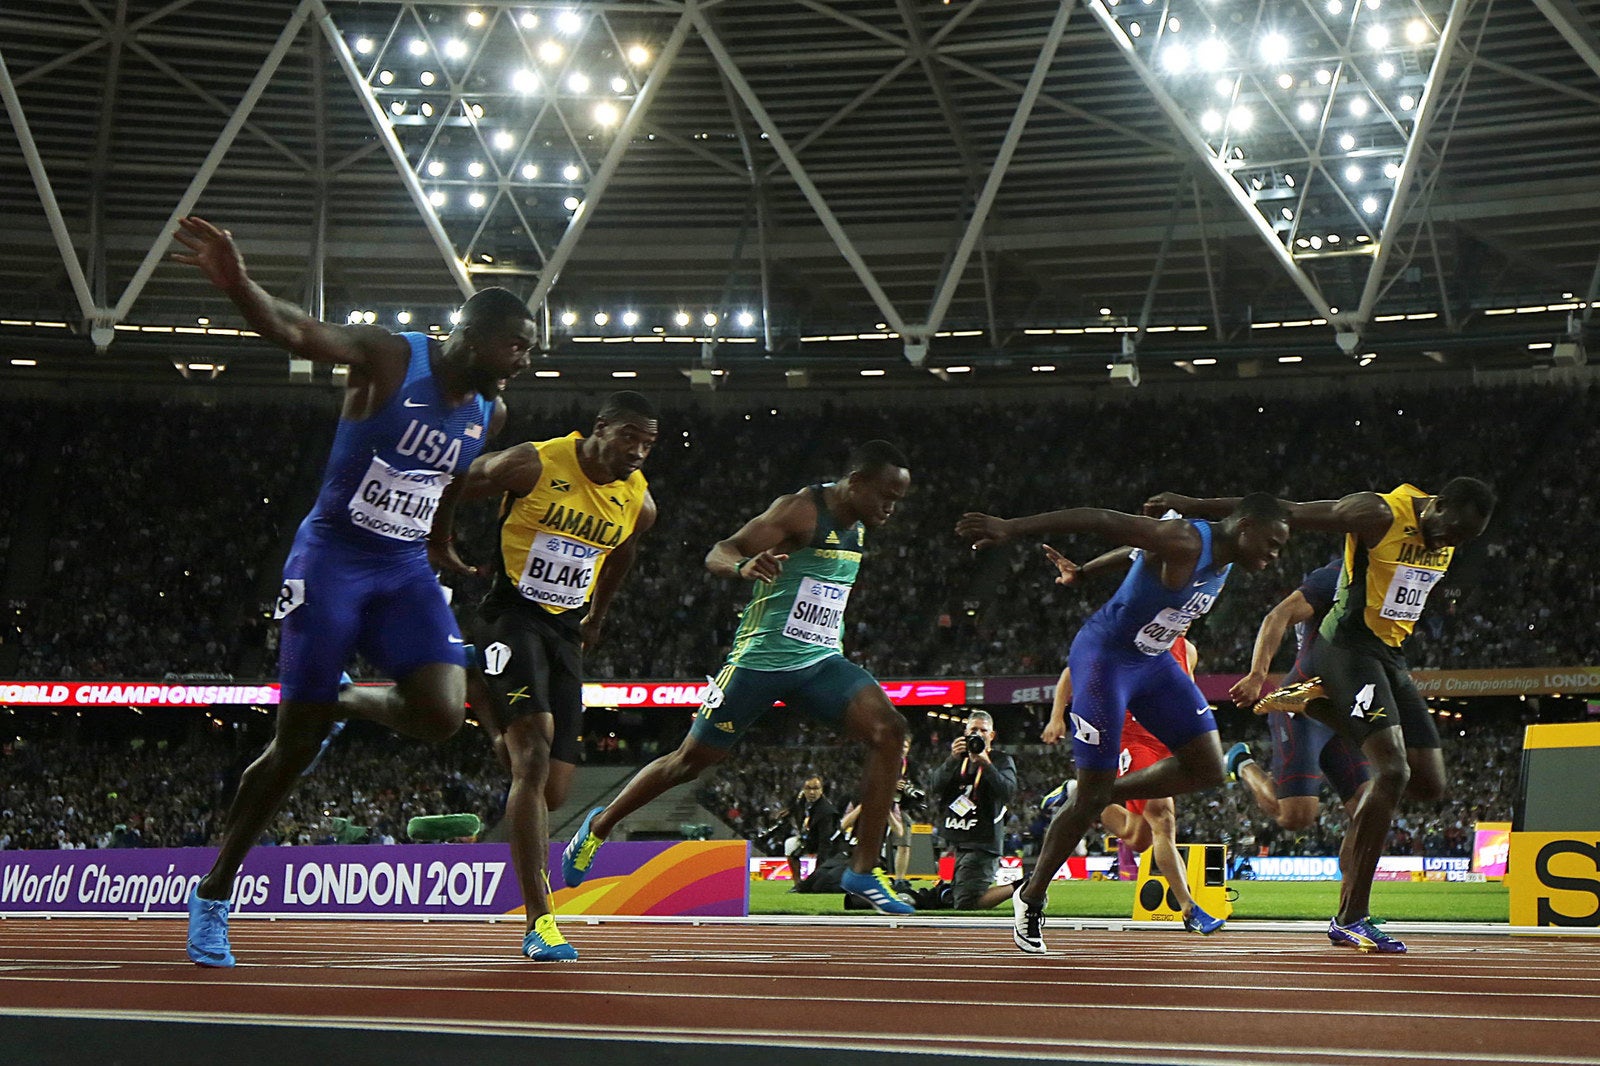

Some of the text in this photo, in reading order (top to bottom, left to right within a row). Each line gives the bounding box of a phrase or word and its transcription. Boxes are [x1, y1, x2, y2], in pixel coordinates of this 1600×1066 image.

[396, 419, 462, 473] USA
[362, 479, 435, 520] GATLIN
[538, 503, 623, 547] JAMAICA
[561, 541, 599, 559] TDK
[528, 557, 591, 589] BLAKE
[1414, 570, 1439, 583] TDK
[277, 584, 293, 612] 8
[520, 585, 567, 604] LONDON
[822, 585, 846, 601] TDK
[1395, 586, 1428, 606] BOL
[793, 601, 842, 629] SIMBINE
[786, 626, 823, 643] LONDON
[1446, 676, 1540, 692] Championships
[75, 685, 272, 704] CHAMPIONSHIPS
[1011, 687, 1040, 703] SEE
[945, 817, 978, 830] IAAF
[1260, 858, 1337, 876] MONDO
[1, 861, 506, 912] World Championips LONDON 2017
